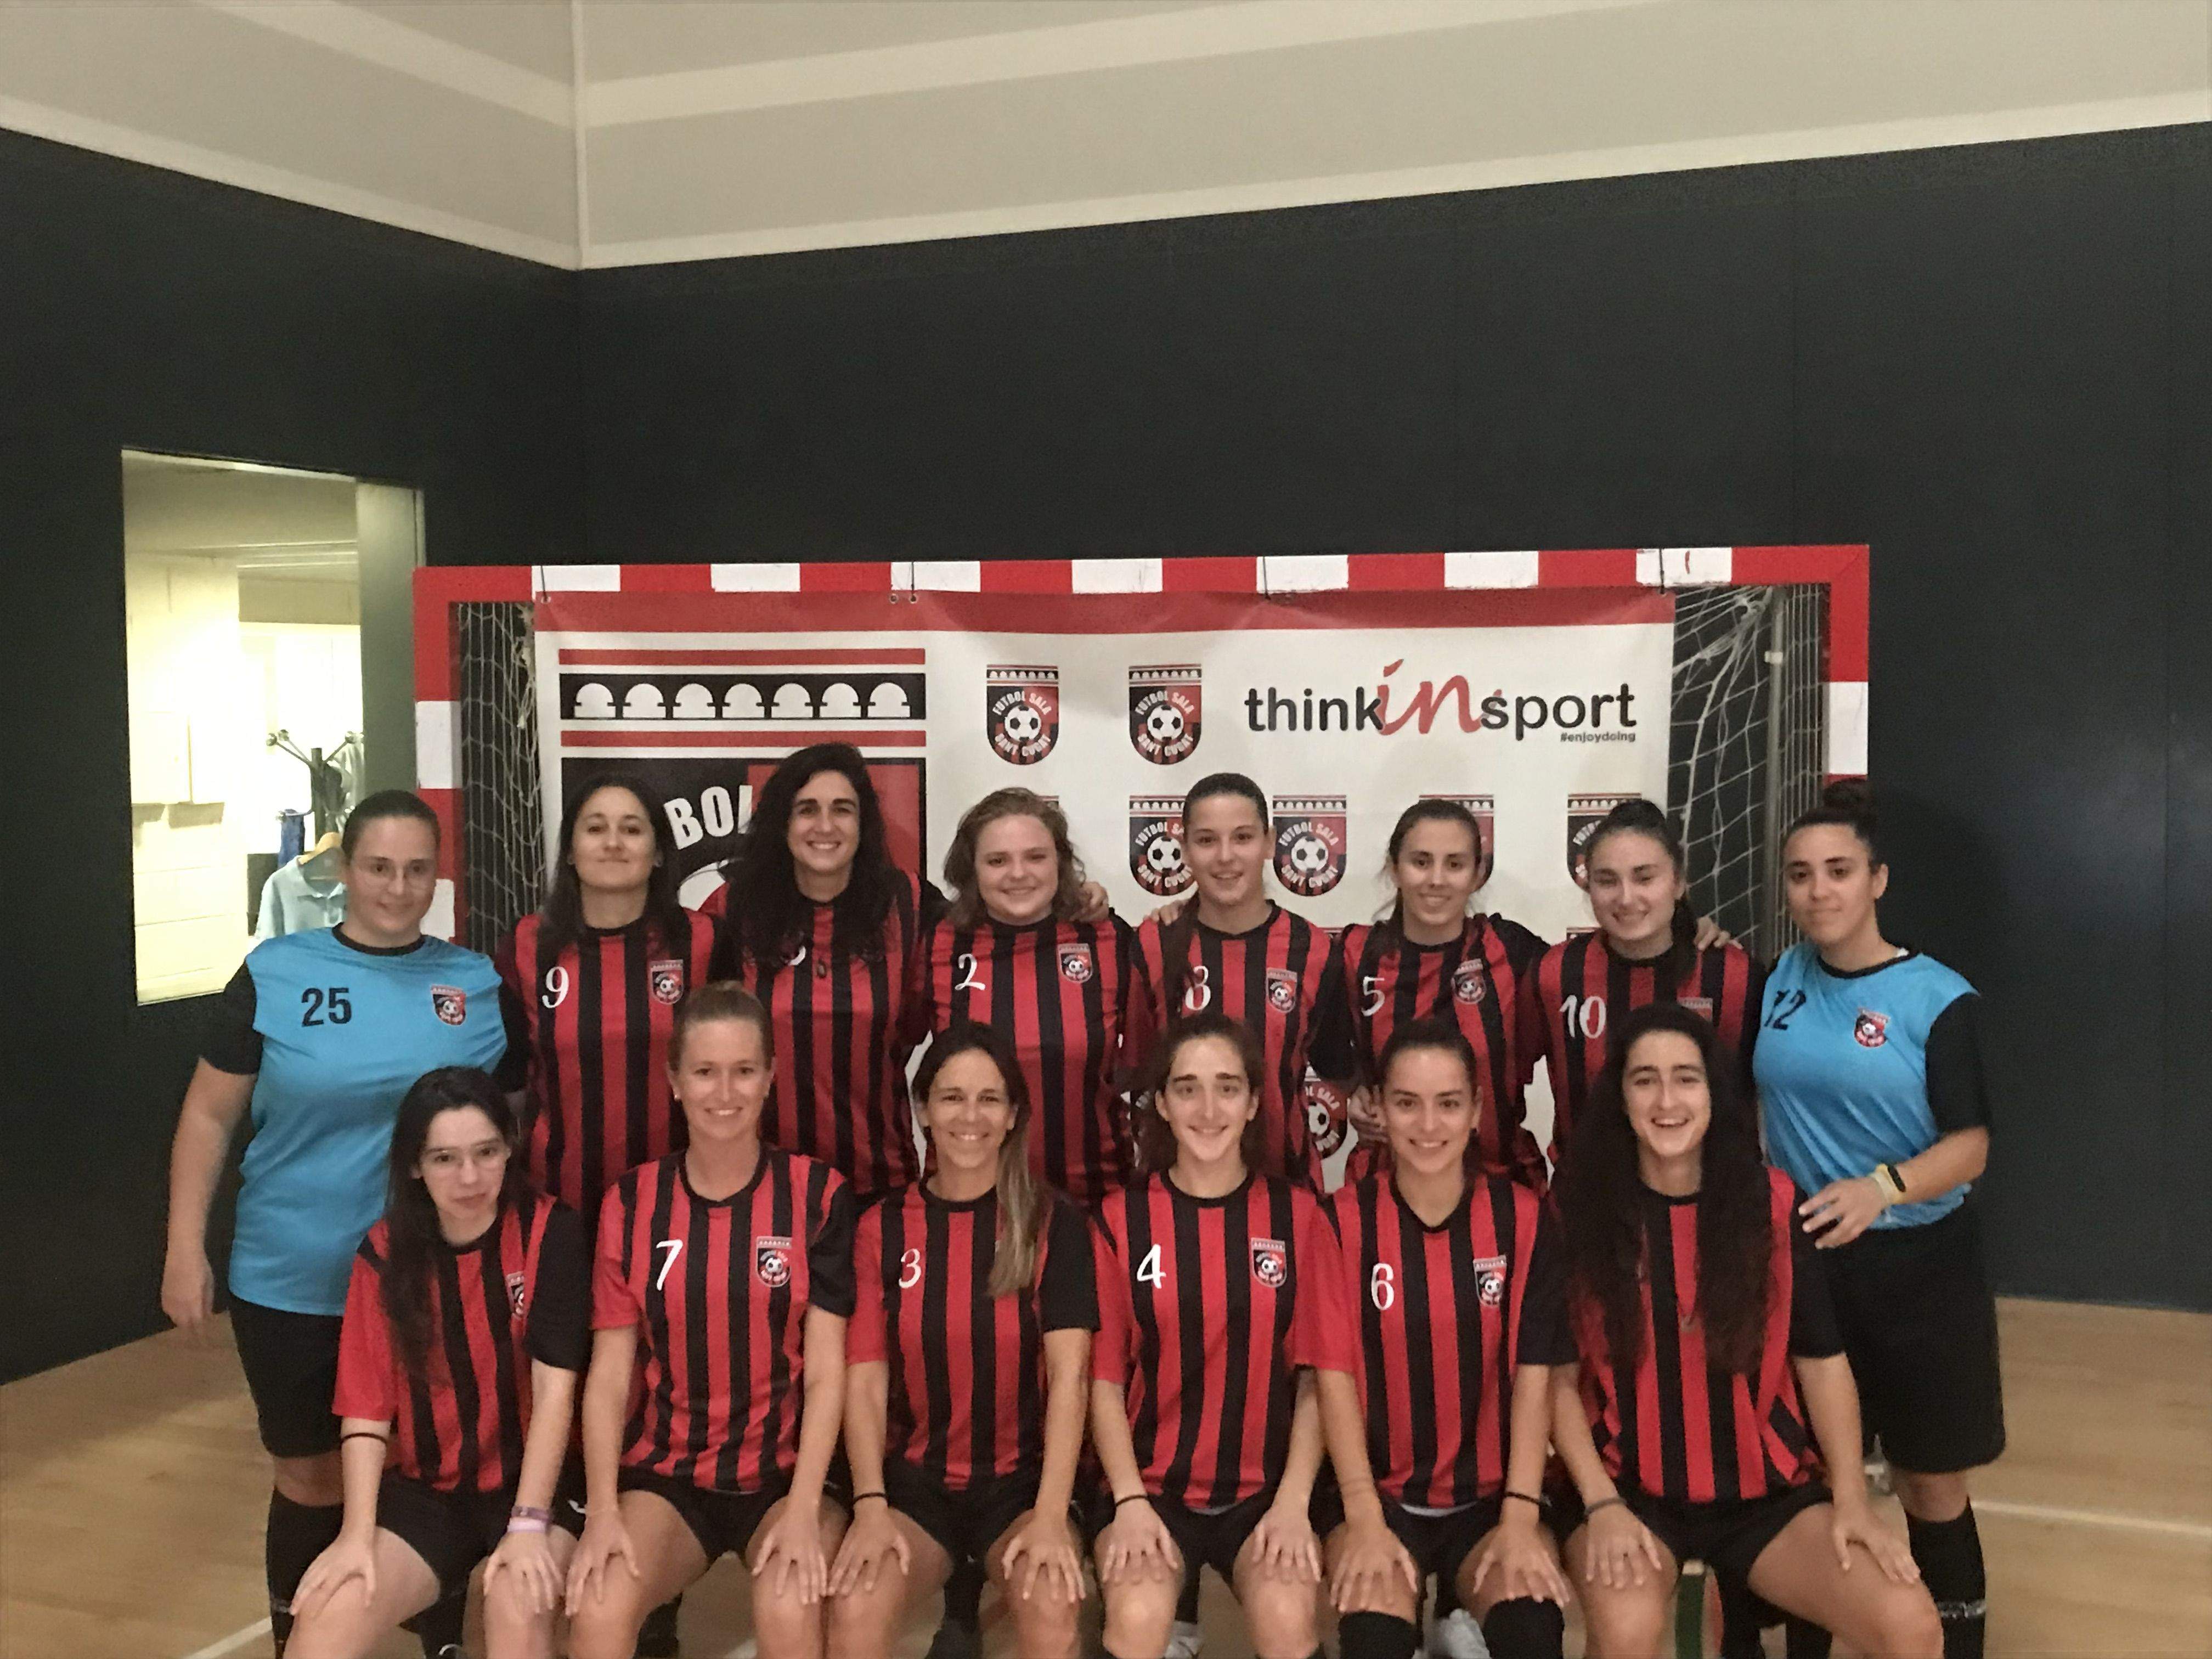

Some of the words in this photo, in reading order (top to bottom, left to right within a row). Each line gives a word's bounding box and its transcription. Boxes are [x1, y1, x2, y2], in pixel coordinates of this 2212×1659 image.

[1560, 731, 1636, 743] #enjoydoing
[1573, 820, 1601, 846] FUTB
[542, 966, 569, 1008] 9
[955, 953, 986, 991] 2
[301, 988, 352, 1027] 25
[1361, 975, 1386, 1017] 5
[1559, 995, 1607, 1039] 10
[1763, 989, 1807, 1031] 12
[656, 1239, 684, 1291] 7
[898, 1248, 922, 1289] 3
[1136, 1243, 1167, 1289] 4
[1370, 1262, 1395, 1311] 6
